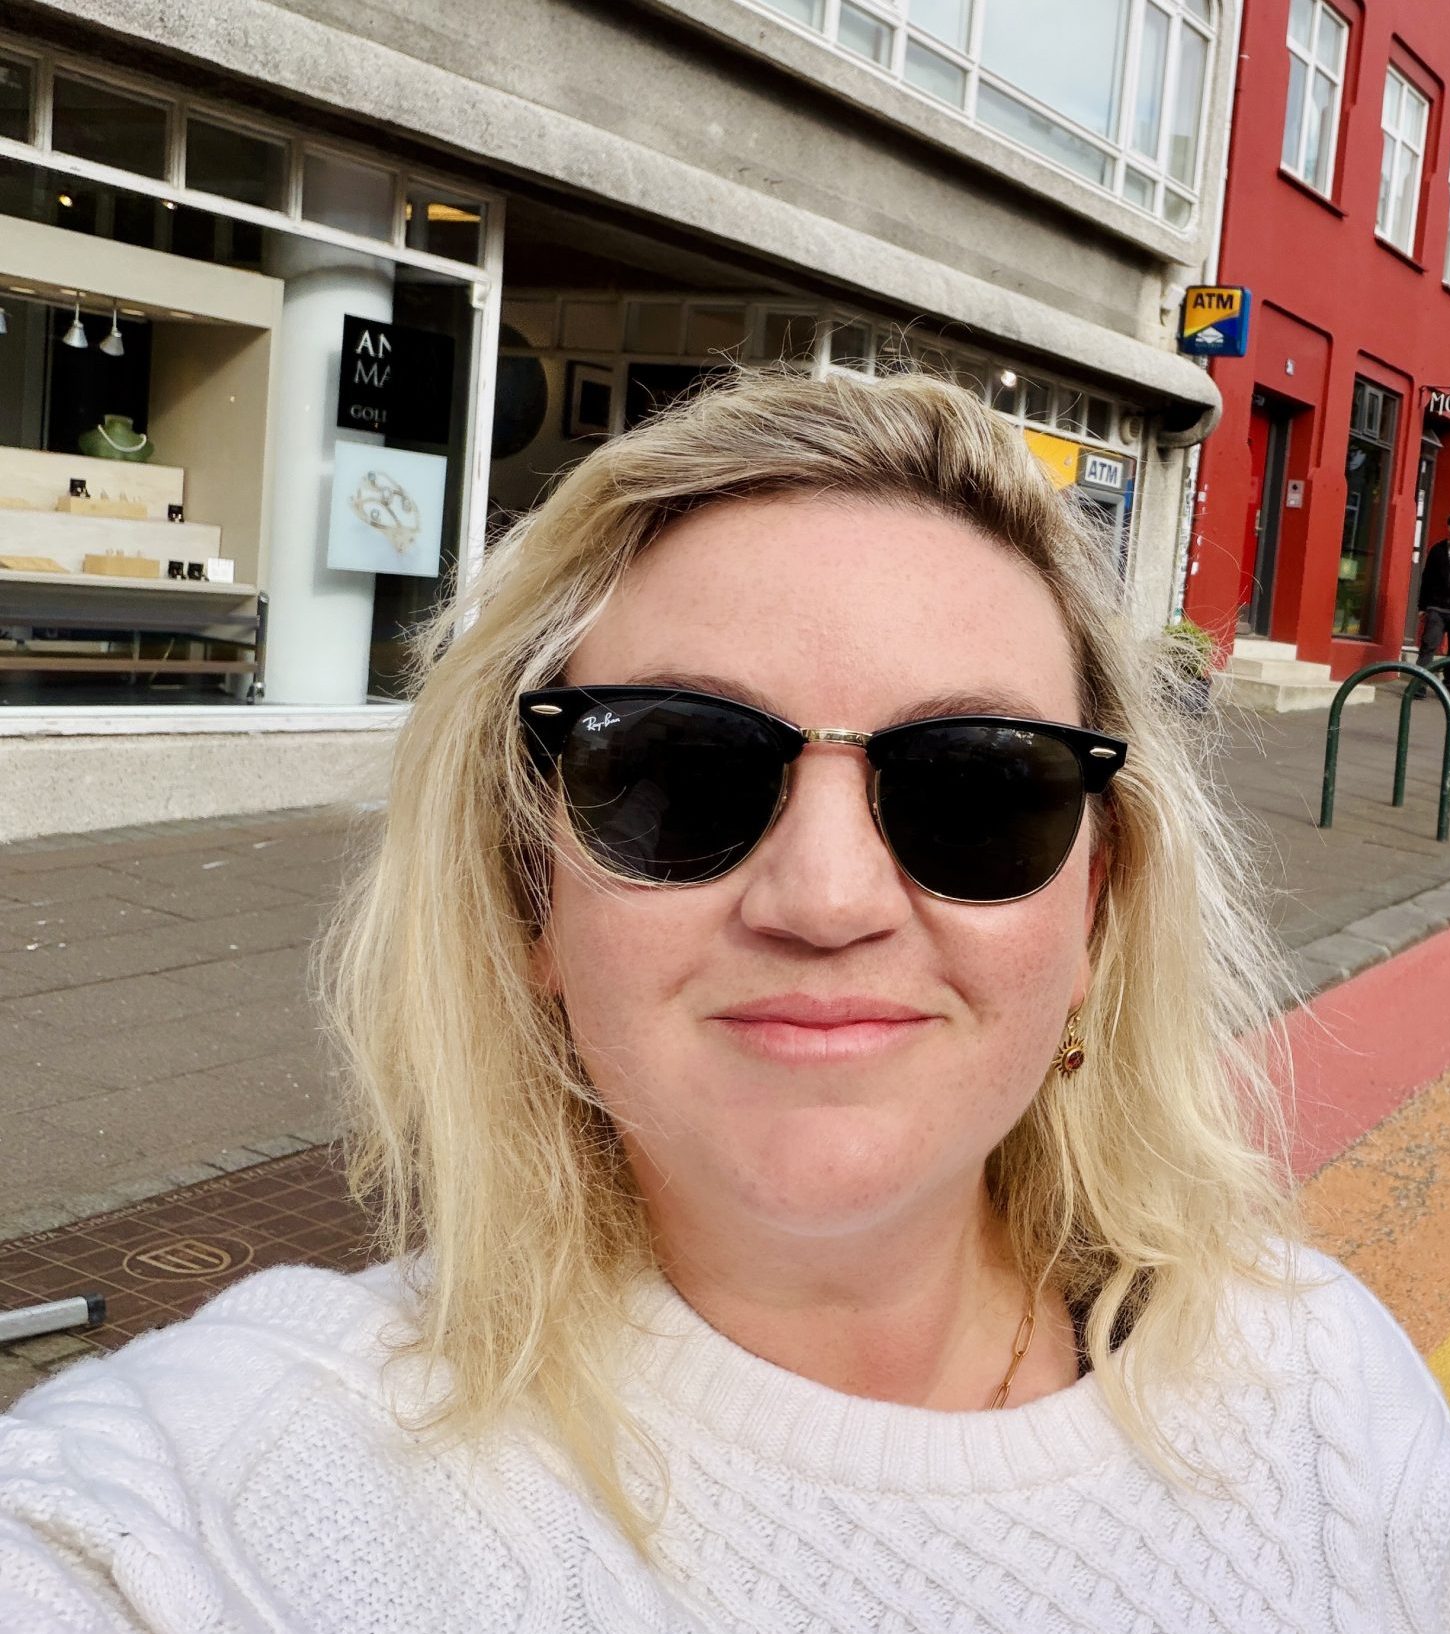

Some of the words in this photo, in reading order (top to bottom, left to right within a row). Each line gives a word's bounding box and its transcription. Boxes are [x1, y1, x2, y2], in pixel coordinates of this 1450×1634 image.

[1192, 292, 1235, 310] ATM
[1087, 460, 1119, 486] ATM
[582, 712, 621, 732] Ray-Ban
